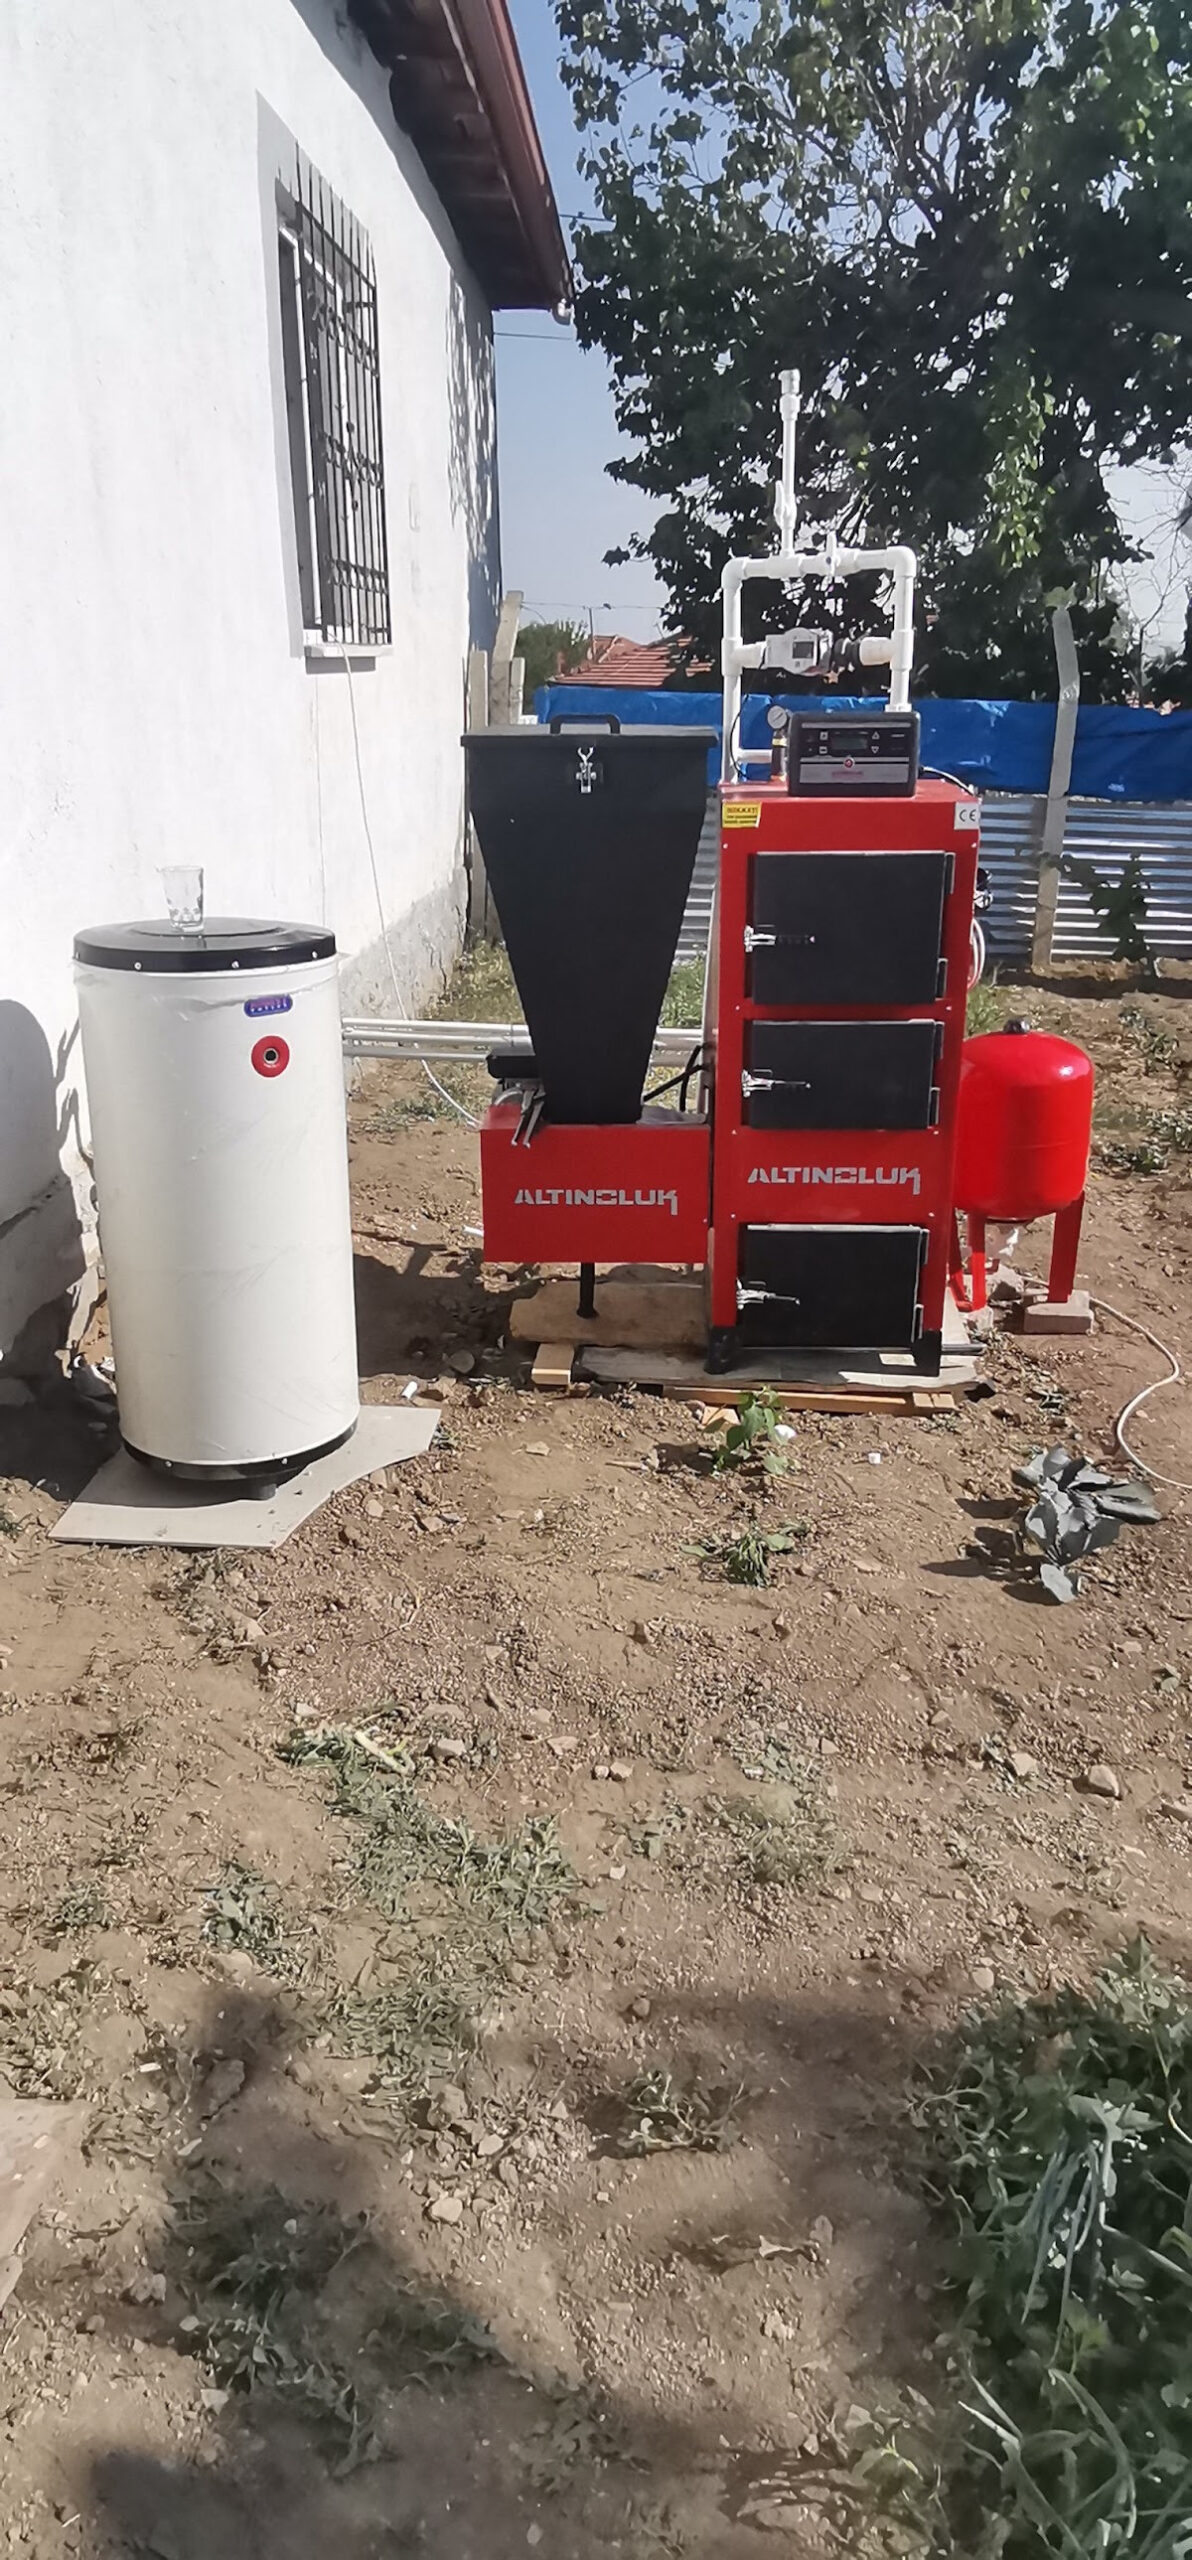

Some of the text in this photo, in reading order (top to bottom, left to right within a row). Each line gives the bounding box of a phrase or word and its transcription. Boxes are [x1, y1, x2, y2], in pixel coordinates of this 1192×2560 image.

[959, 809, 976, 822] CE
[747, 1167, 921, 1196] ALTINOLUK
[514, 1188, 678, 1216] ALTINOLUK
